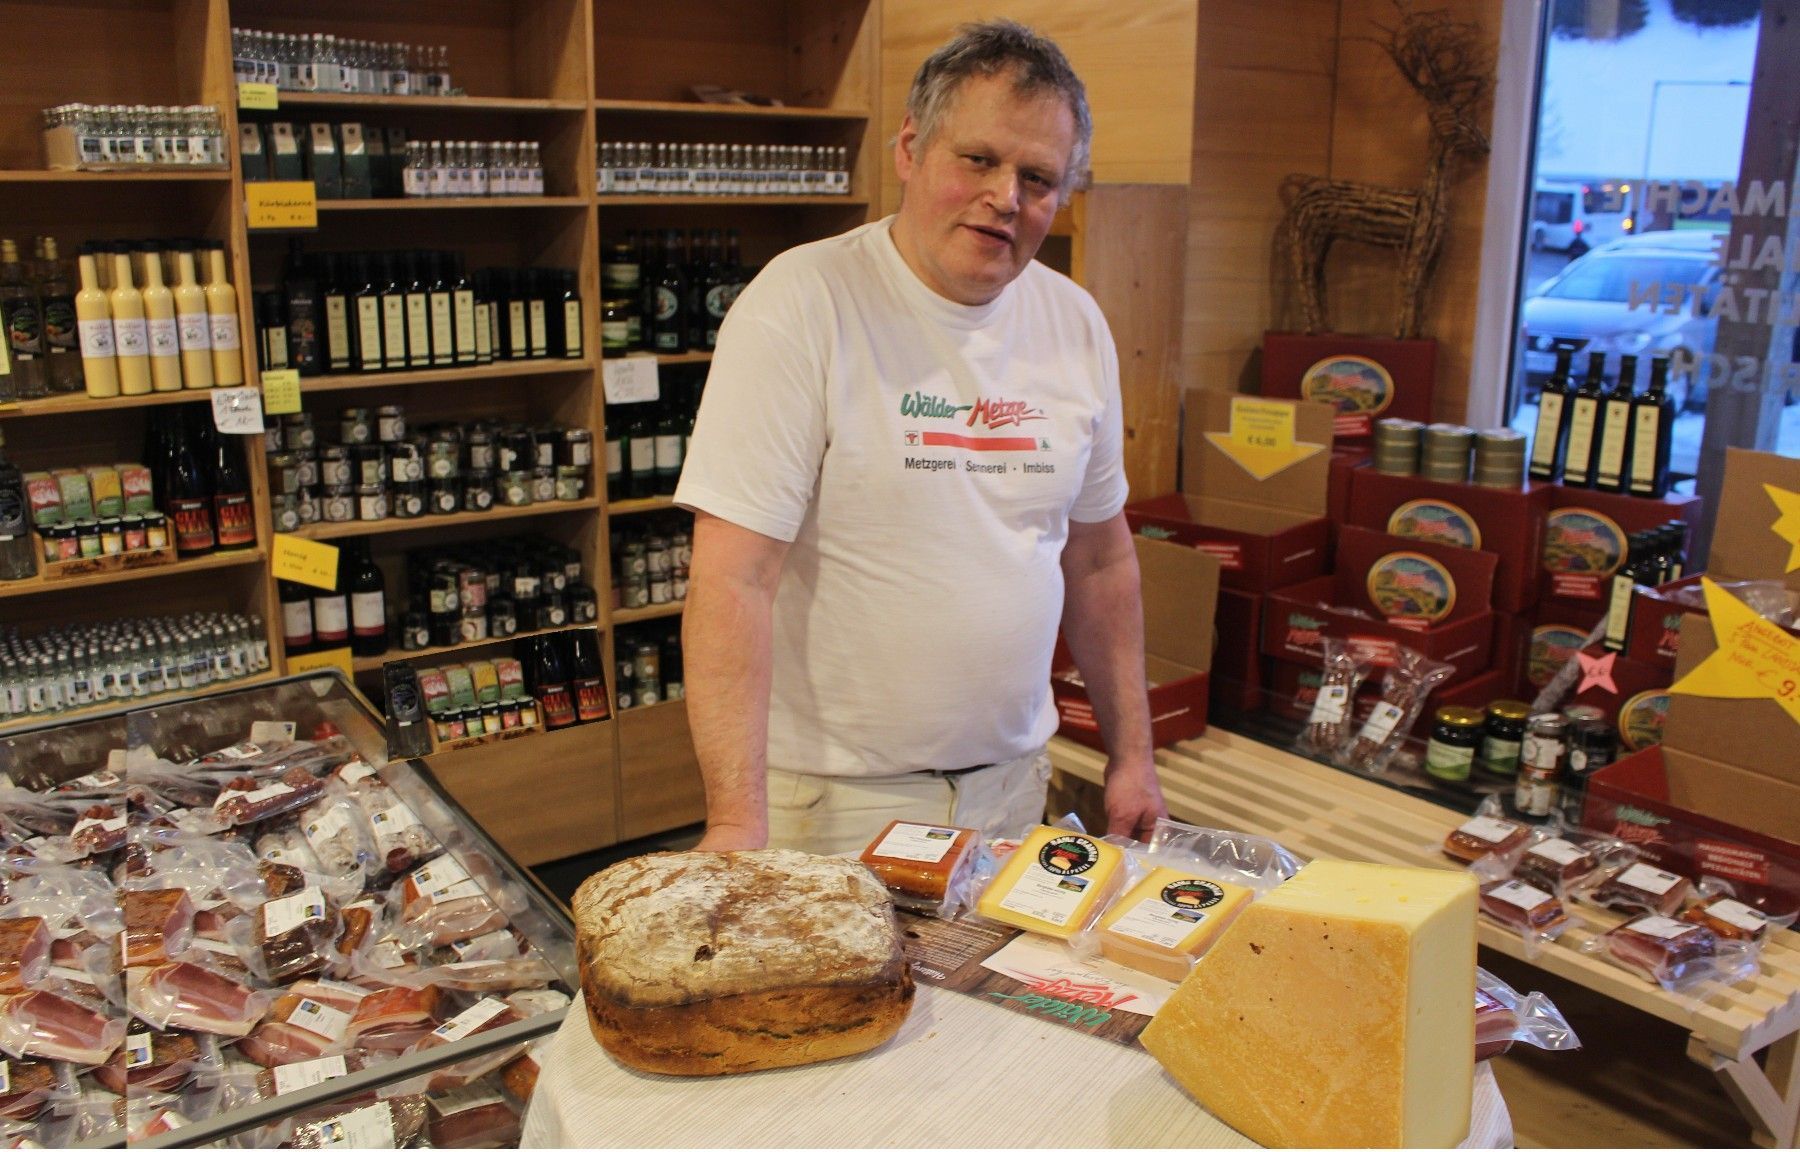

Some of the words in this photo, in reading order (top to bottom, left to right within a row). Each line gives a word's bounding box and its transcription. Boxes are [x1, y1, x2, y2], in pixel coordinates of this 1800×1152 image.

[900, 390, 972, 419] Wälder
[966, 396, 1041, 430] Metzge
[904, 457, 957, 474] Metzgerei
[1023, 461, 1055, 474] Imbiss
[988, 992, 1112, 1027] Wälder
[1014, 973, 1139, 1011] Metzge
